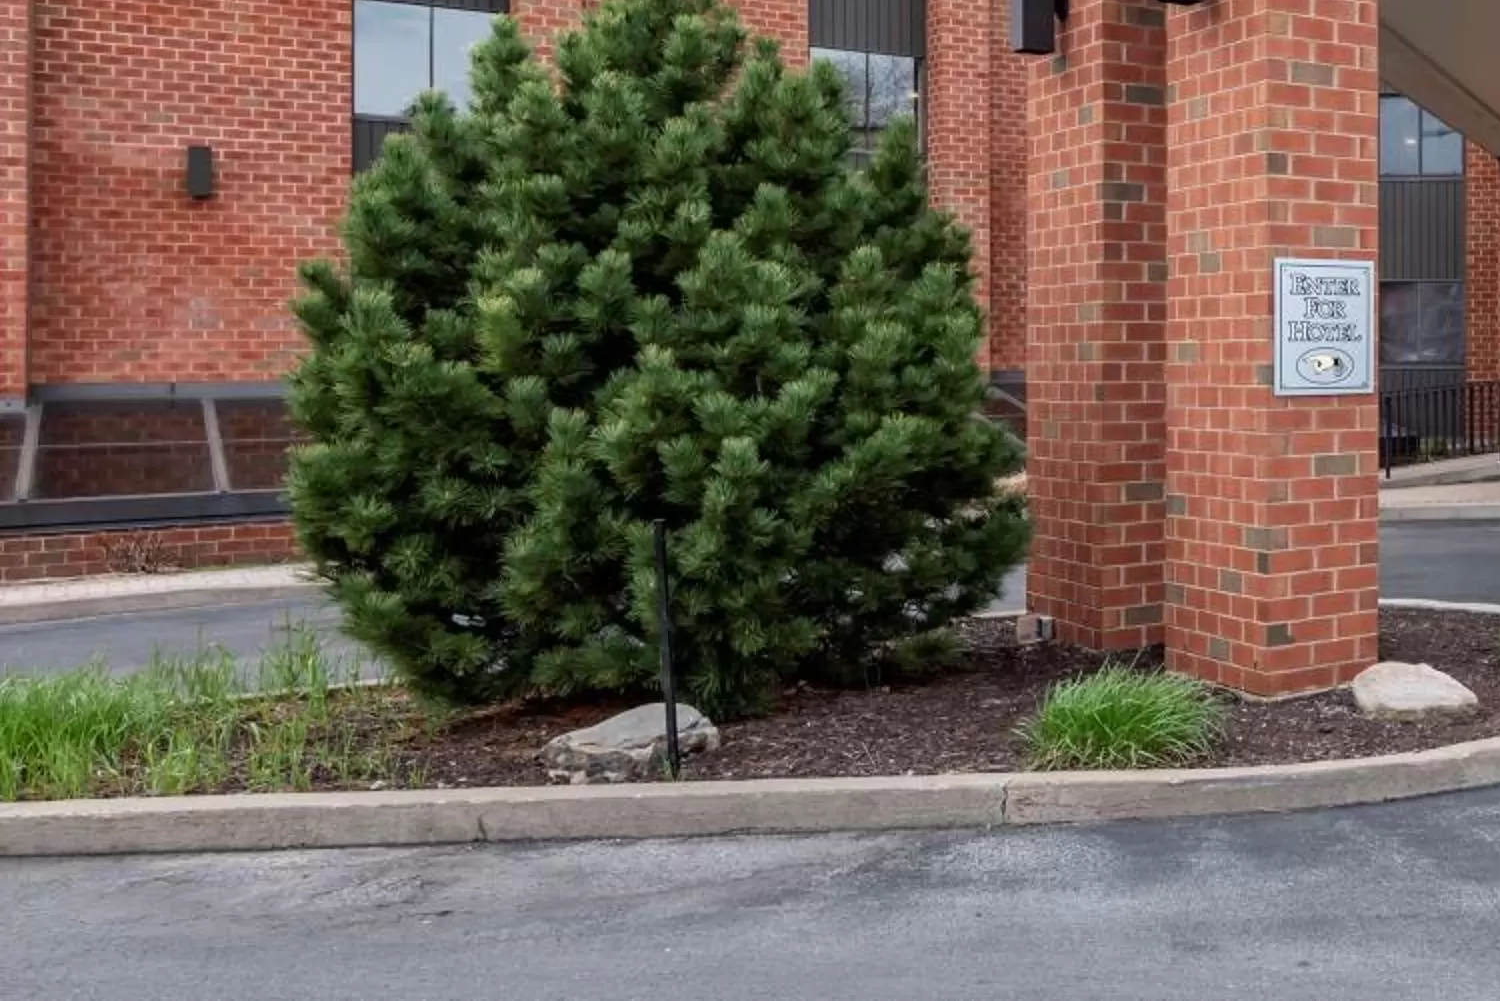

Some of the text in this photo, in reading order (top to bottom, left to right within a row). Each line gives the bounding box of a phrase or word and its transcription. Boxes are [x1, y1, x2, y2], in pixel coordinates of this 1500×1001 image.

[1289, 273, 1361, 296] ENTER
[1303, 296, 1347, 319] FOR
[1288, 320, 1363, 342] HOTEL
